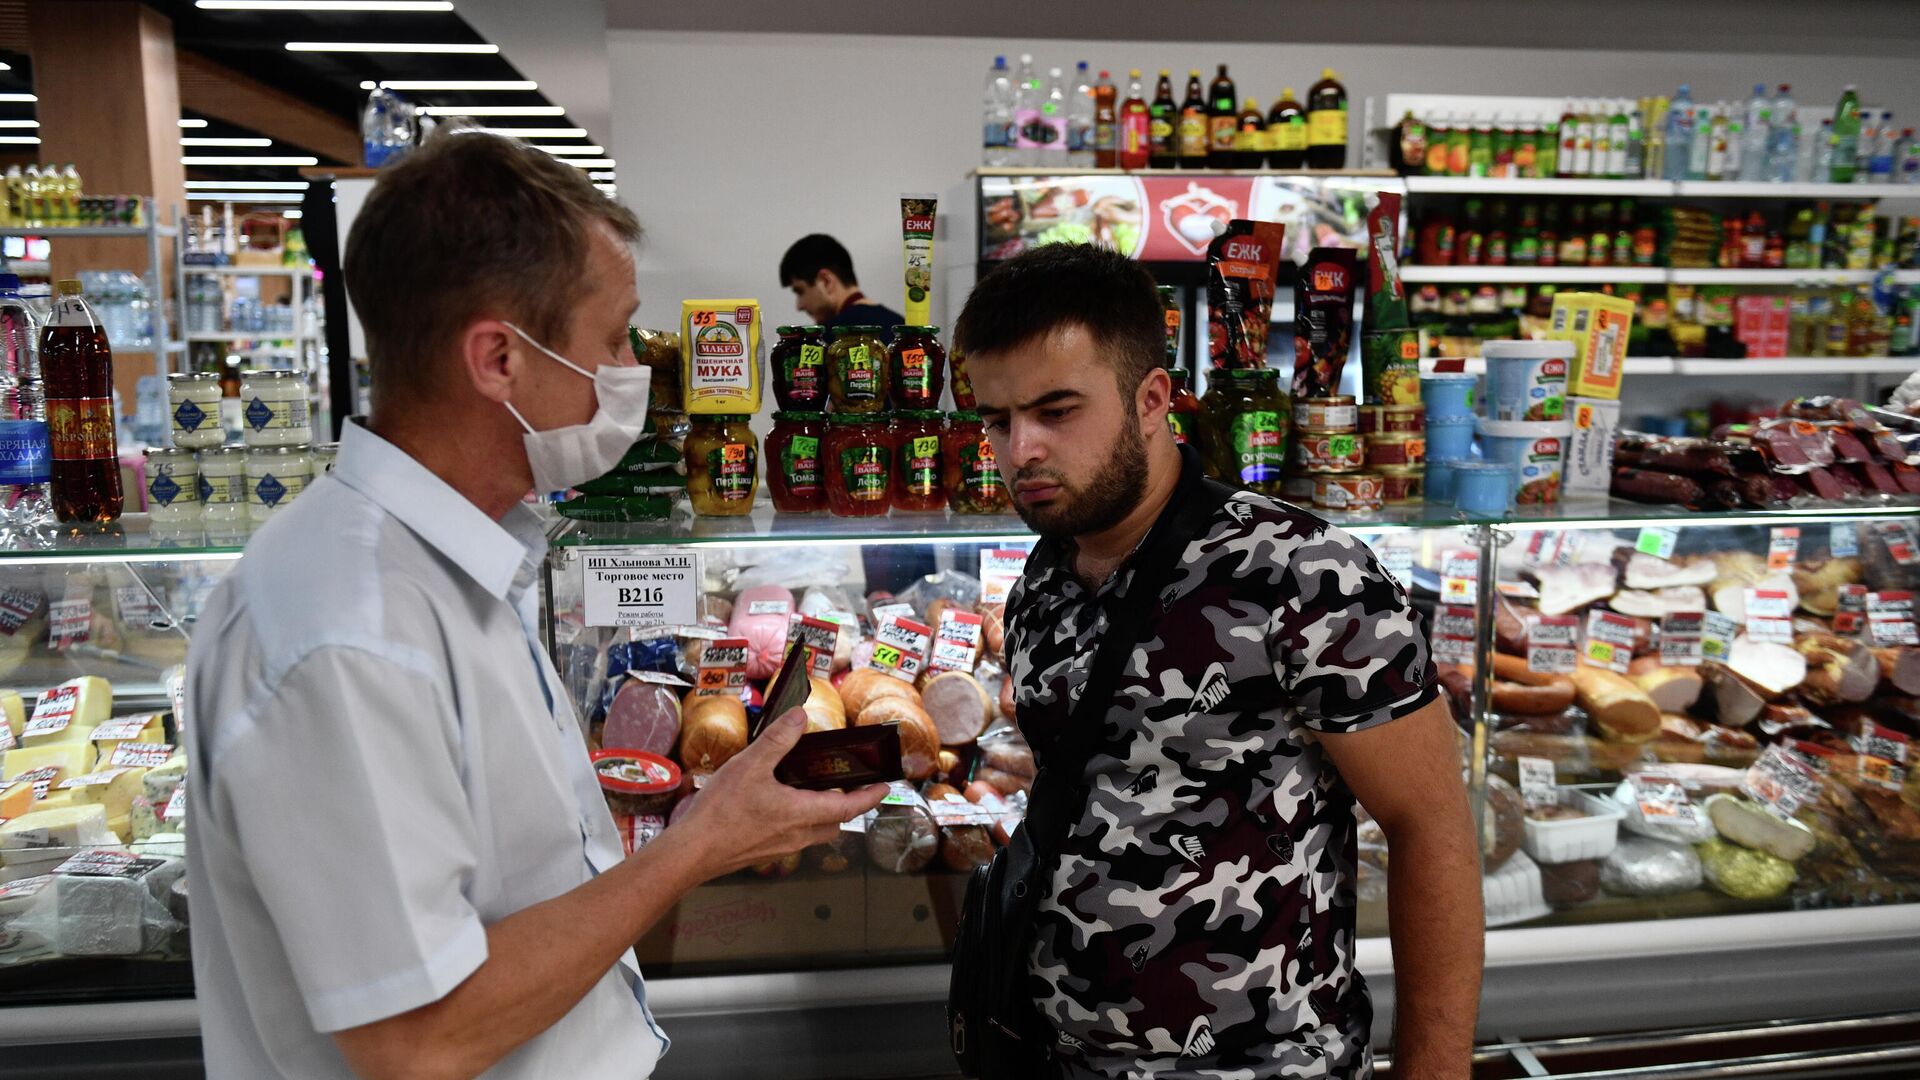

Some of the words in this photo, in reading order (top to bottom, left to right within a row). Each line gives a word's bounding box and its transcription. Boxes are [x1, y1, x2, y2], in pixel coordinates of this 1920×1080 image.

[906, 220, 932, 230] ЕЖК
[1227, 242, 1262, 260] ЕЖК
[693, 311, 714, 325] 55
[804, 348, 820, 362] 70
[697, 365, 743, 377] МУКА
[850, 381, 871, 390] Перец
[916, 440, 937, 452] 130
[857, 478, 881, 486] Лечо
[1236, 503, 1254, 520] NIKE
[588, 558, 607, 568] ИП
[610, 557, 661, 567] Хлынова
[664, 557, 691, 567] М.Н.
[595, 571, 649, 583] Торговое
[651, 572, 684, 581] место
[640, 611, 664, 619] работы
[873, 647, 900, 663] 510
[902, 659, 916, 670] 00
[1200, 676, 1232, 714] NIKE
[1182, 835, 1206, 858] NIKE
[1187, 1028, 1216, 1057] NIK
